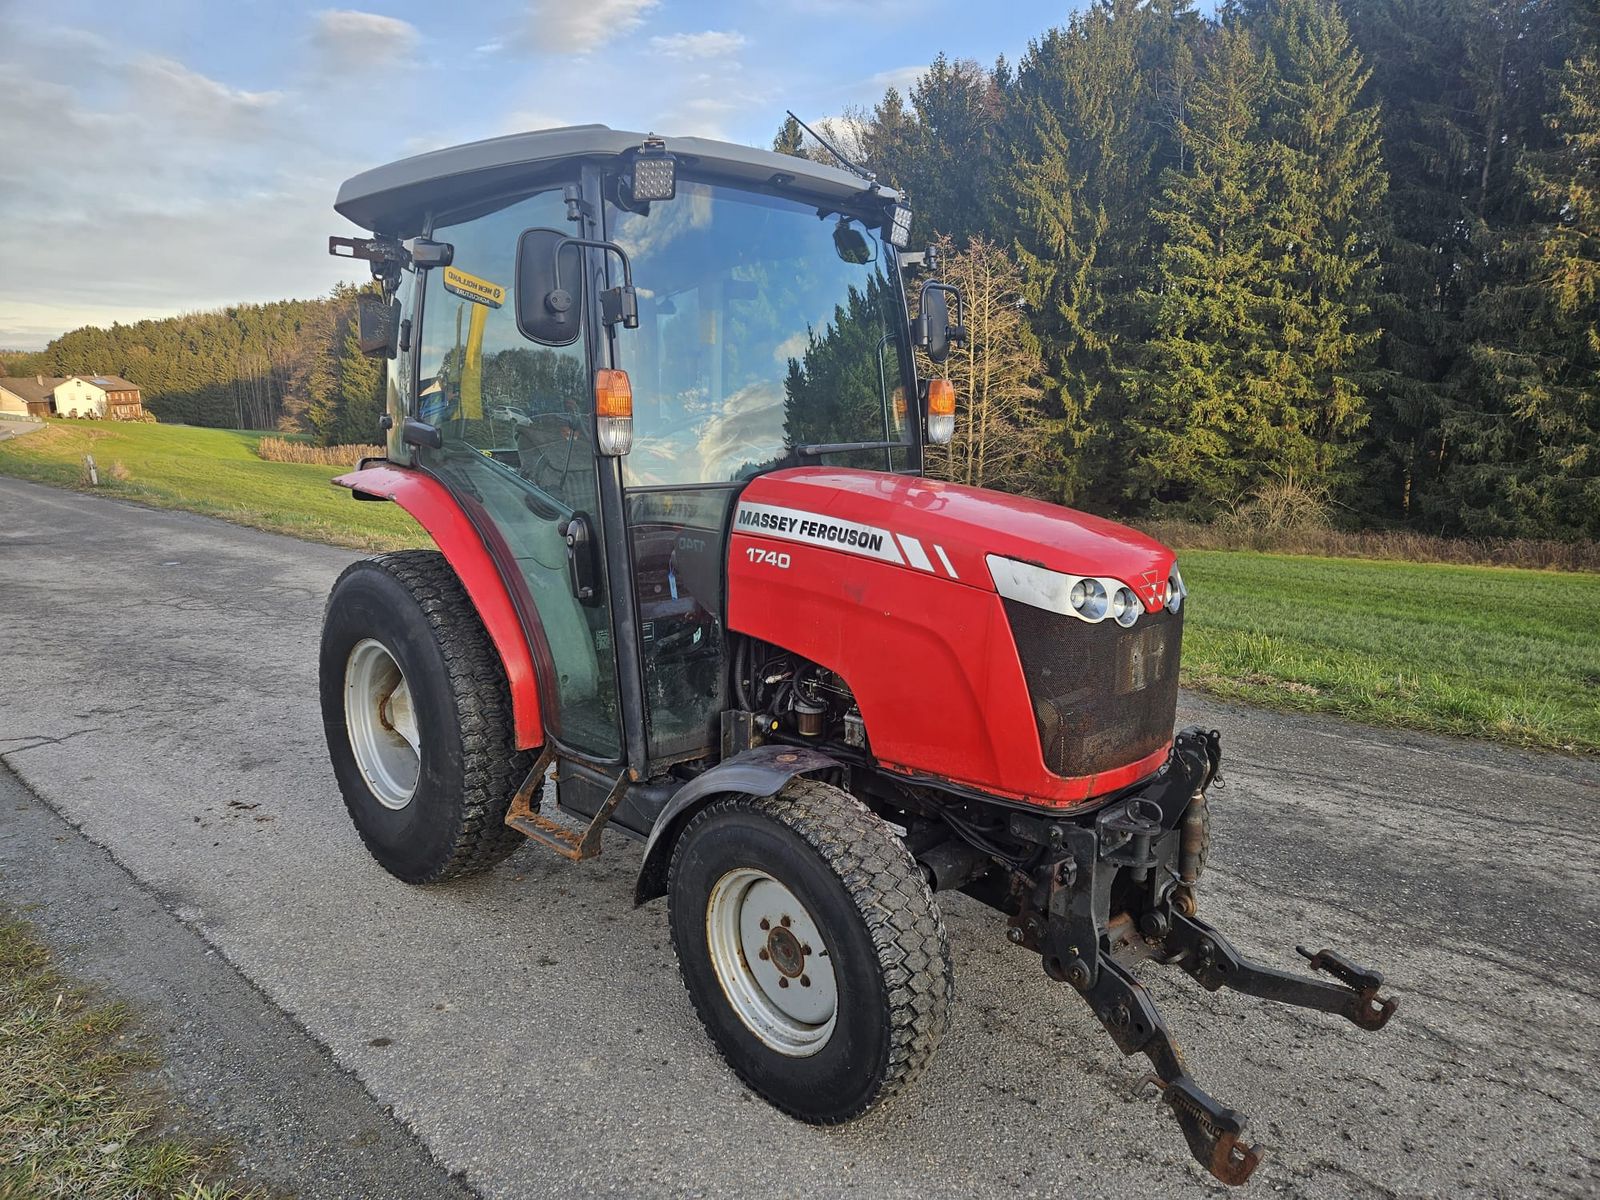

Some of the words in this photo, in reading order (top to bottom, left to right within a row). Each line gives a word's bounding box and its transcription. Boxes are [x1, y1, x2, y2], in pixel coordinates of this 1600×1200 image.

[738, 509, 798, 532] MASSEY
[799, 520, 883, 551] FERGUSON
[746, 547, 791, 570] 1740
